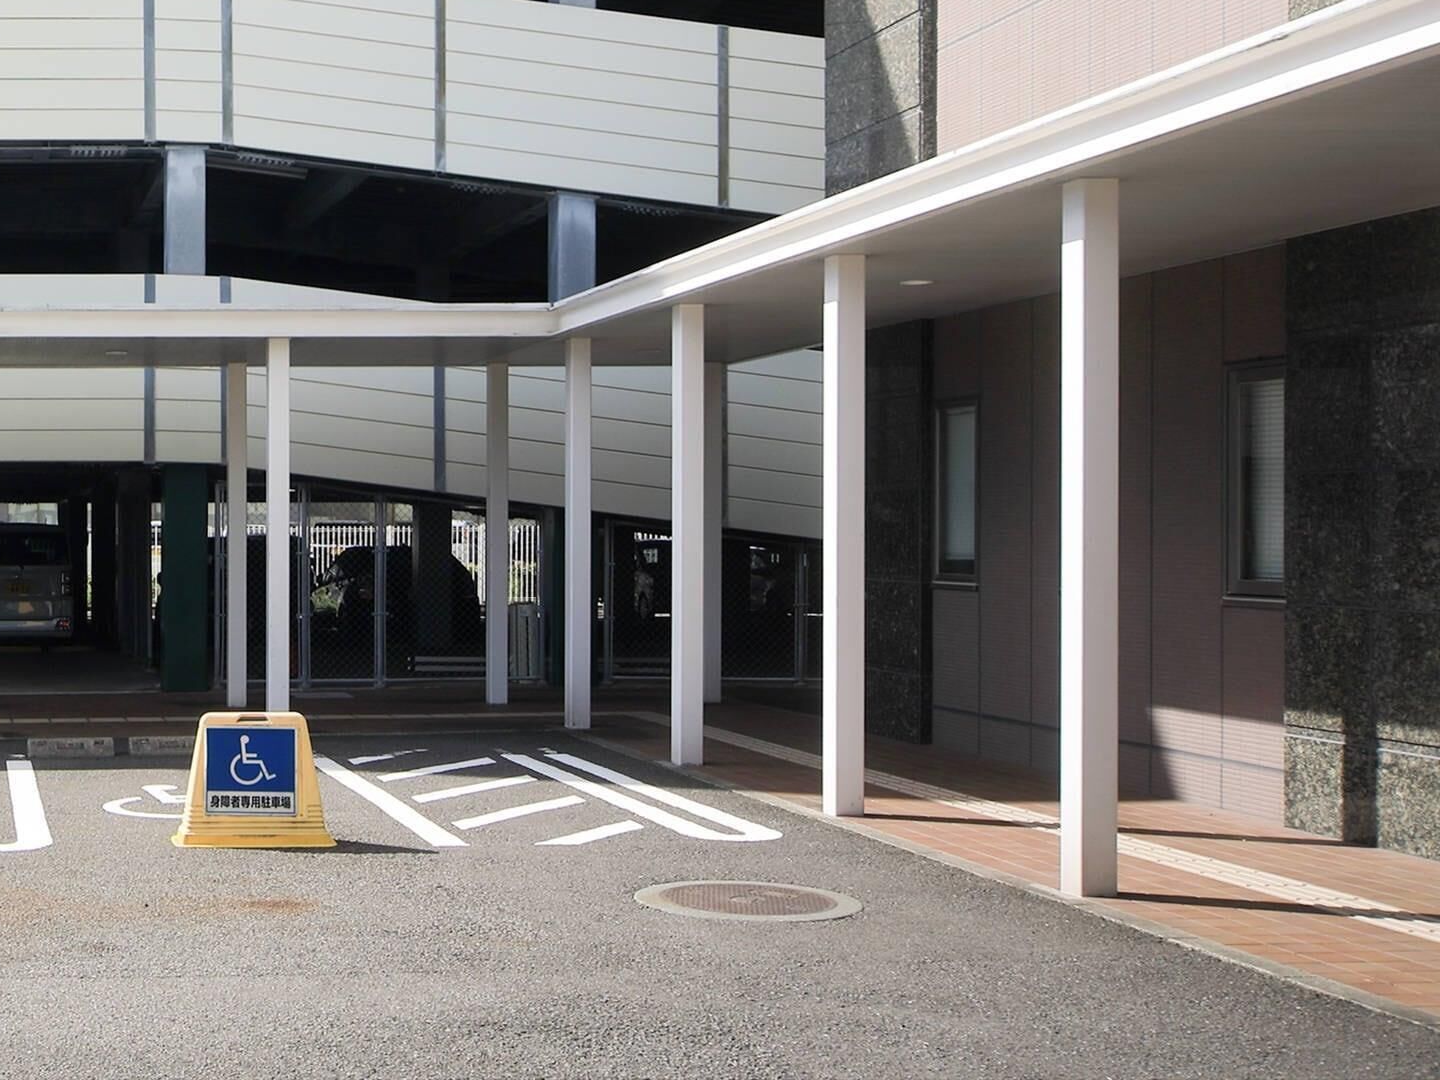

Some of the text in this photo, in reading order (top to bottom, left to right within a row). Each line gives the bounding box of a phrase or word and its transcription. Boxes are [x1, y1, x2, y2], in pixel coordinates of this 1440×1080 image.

[210, 795, 291, 809] 身障者専用駐車場
